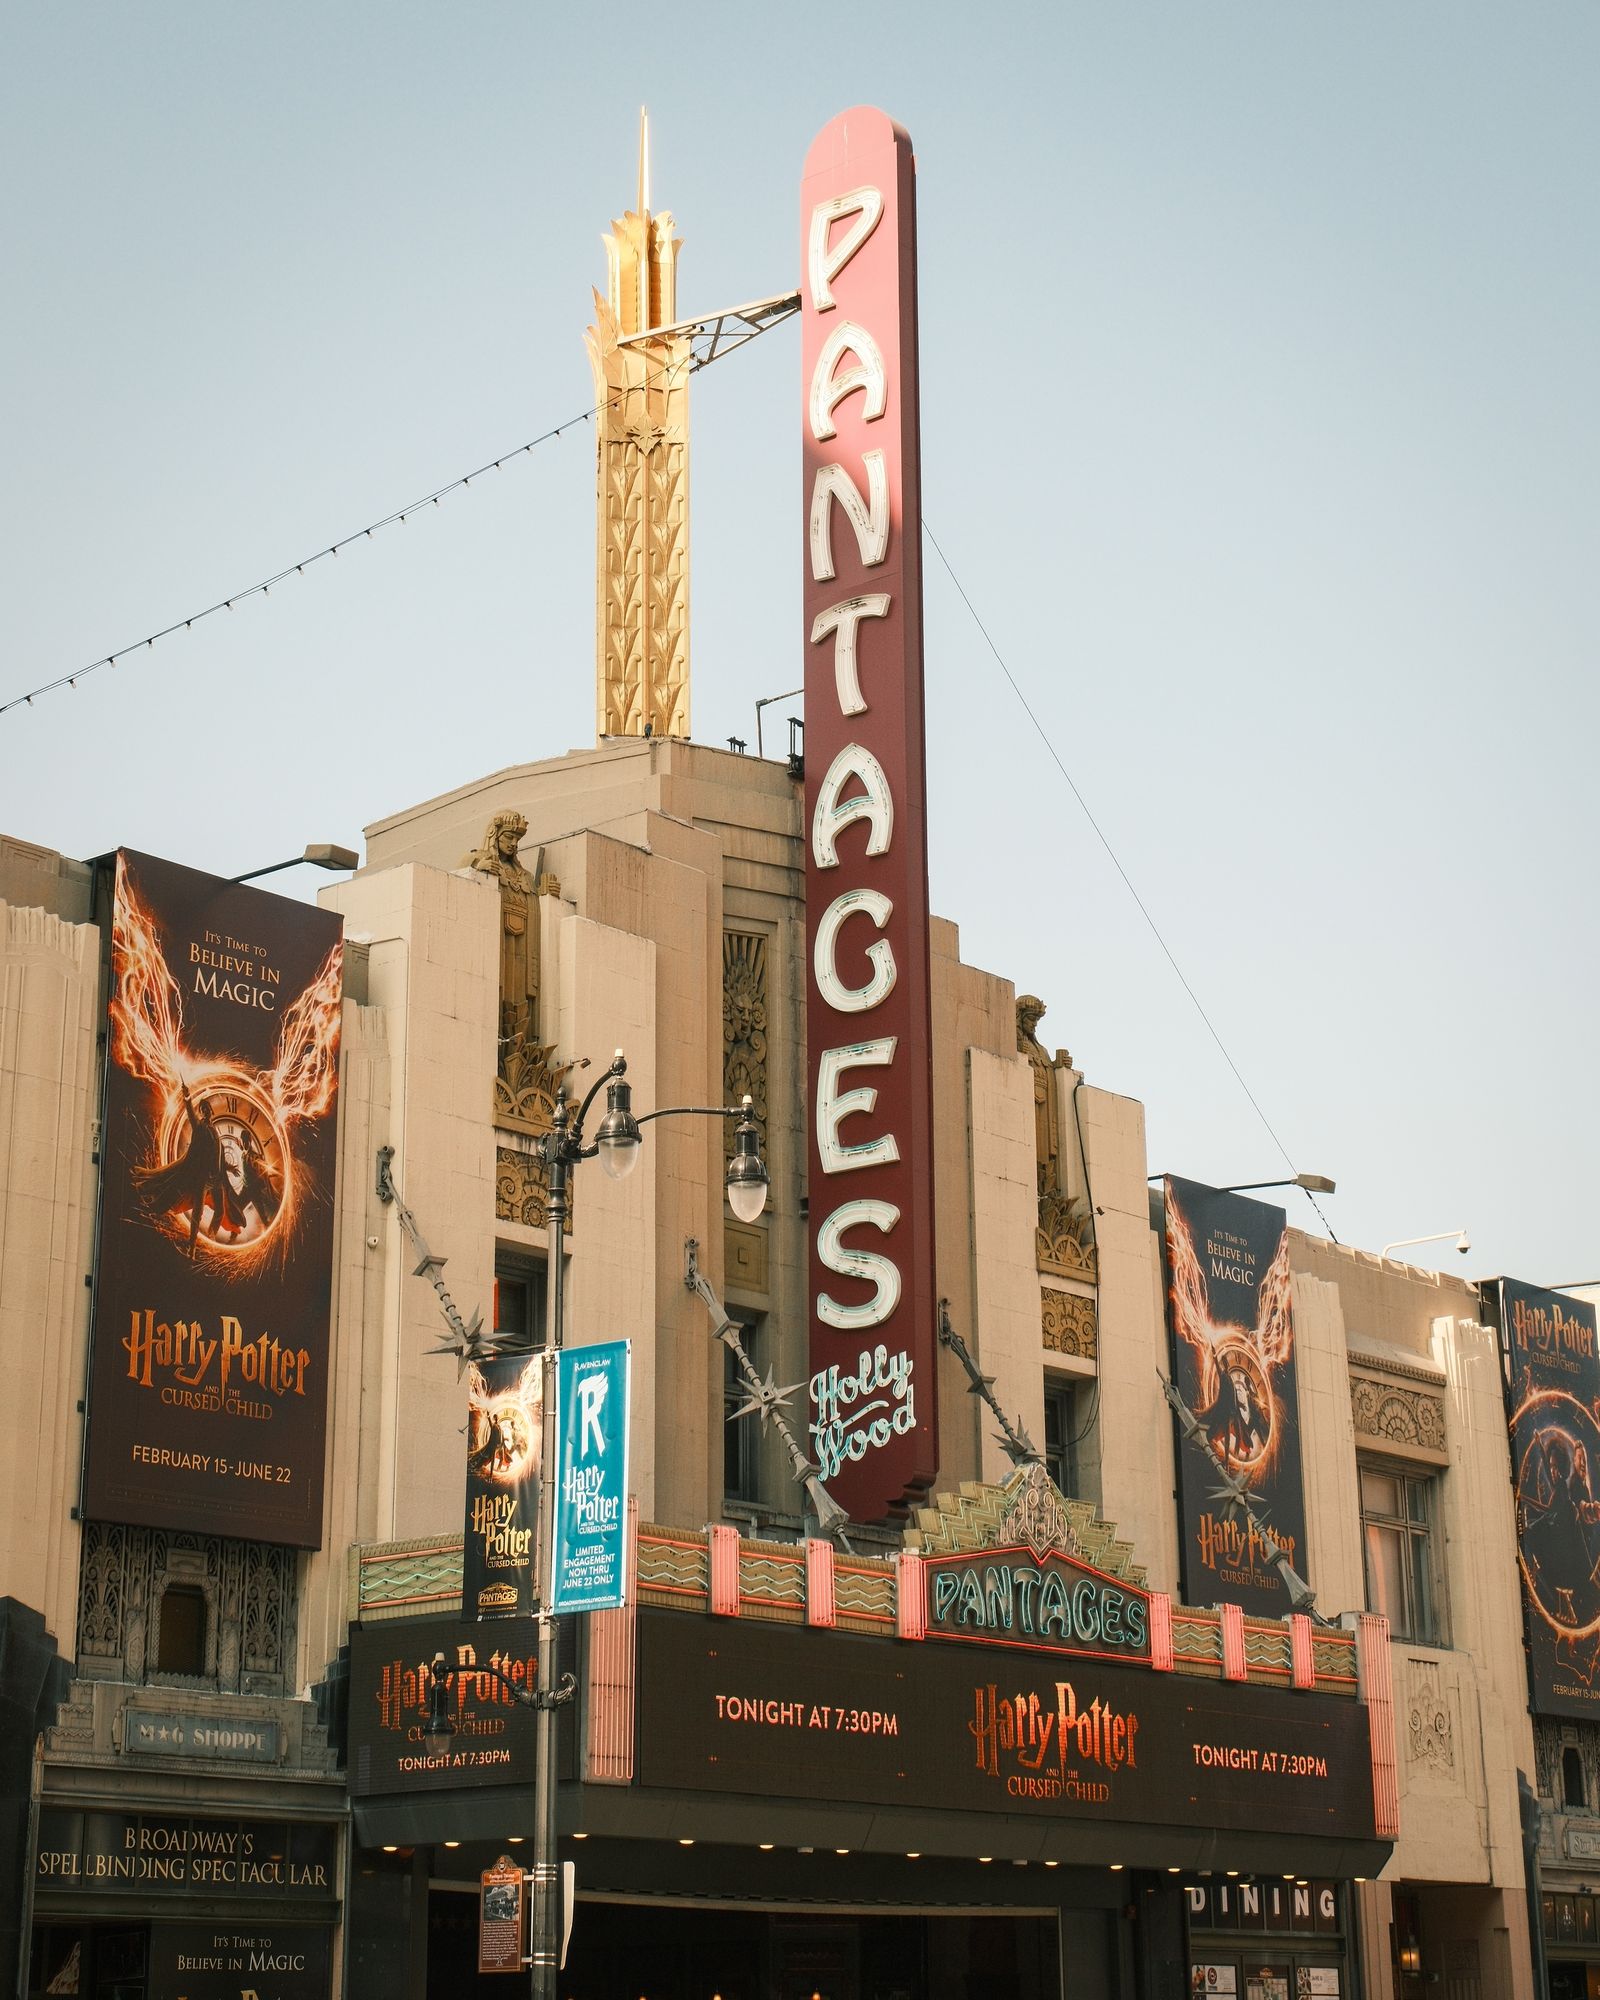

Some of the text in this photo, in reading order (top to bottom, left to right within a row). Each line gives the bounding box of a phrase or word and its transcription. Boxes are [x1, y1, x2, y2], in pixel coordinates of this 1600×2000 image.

[808, 184, 905, 1329] PANTAGES
[225, 936, 250, 952] TIME
[253, 946, 267, 957] TO
[189, 942, 280, 985] BELIEVE IN
[193, 967, 275, 1011] MAGIC
[1207, 1239, 1255, 1266] BELIEVE IN
[1211, 1257, 1254, 1287] MAGIC
[1513, 1299, 1594, 1360] Harry Potter
[122, 1308, 311, 1405] Harry Potter
[574, 1359, 611, 1371] RAVENCLAW
[204, 1385, 241, 1398] AND THE
[809, 1344, 913, 1425] Holly
[161, 1387, 273, 1420] CURSED CHILD
[808, 1384, 917, 1482] Wood
[133, 1445, 210, 1472] FEBRUARY
[276, 1467, 291, 1483] 22
[562, 1464, 605, 1504] Harry
[470, 1493, 517, 1534] Harry
[576, 1491, 619, 1534] Potter
[579, 1523, 618, 1534] CURSED CHILD
[1196, 1512, 1247, 1570] Harry
[485, 1522, 532, 1566] Potter
[575, 1545, 604, 1557] LIMITED
[487, 1558, 530, 1568] CURSED CHILD
[563, 1553, 615, 1568] ENGAGEMENT
[568, 1565, 610, 1578] NOW THRU
[562, 1574, 615, 1589] JUNE 22 ONLY
[1220, 1569, 1251, 1586] CURSED
[480, 1590, 517, 1603] PANTAGES
[934, 1564, 1147, 1648] PANTAGES
[1552, 1684, 1583, 1698] FEBRUARY
[462, 1718, 505, 1737] CHILD
[715, 1695, 898, 1736] TONIGHT AT 7:30PM
[193, 1727, 266, 1751] SHOPPE
[968, 1682, 1139, 1789] Harry Potter
[398, 1750, 511, 1771] TONIGHT AT 7:30PM
[1045, 1768, 1079, 1778] AND THE
[1193, 1744, 1327, 1777] TONIGHT AT 7:30PM
[1007, 1775, 1110, 1802] CURSED CHILD
[38, 1852, 328, 1887] SPELLBINDING SPECTACULAR
[1190, 1886, 1336, 1918] DINING
[213, 1935, 272, 1949] IT'S TIME TO
[177, 1951, 305, 1972] BELIEVE IN MAGIC
